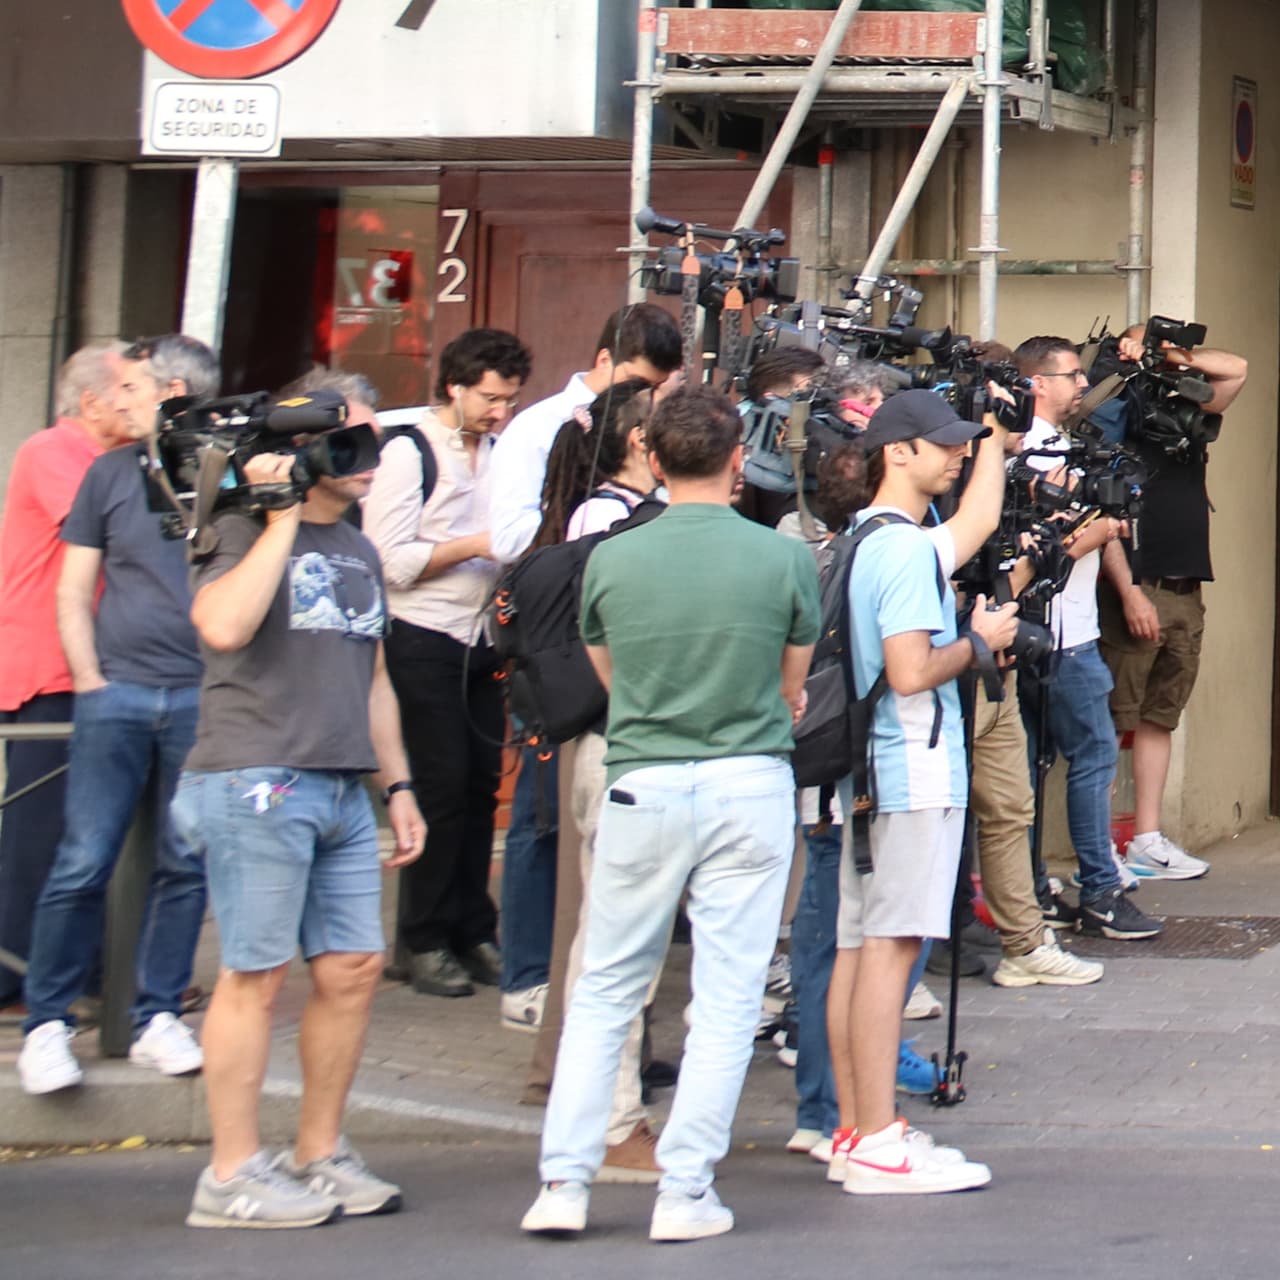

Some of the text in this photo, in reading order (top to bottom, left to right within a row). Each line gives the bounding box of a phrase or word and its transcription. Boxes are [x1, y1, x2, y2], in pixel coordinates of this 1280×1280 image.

[175, 98, 257, 114] ZONA DE
[161, 121, 268, 138] SEGURIDAD
